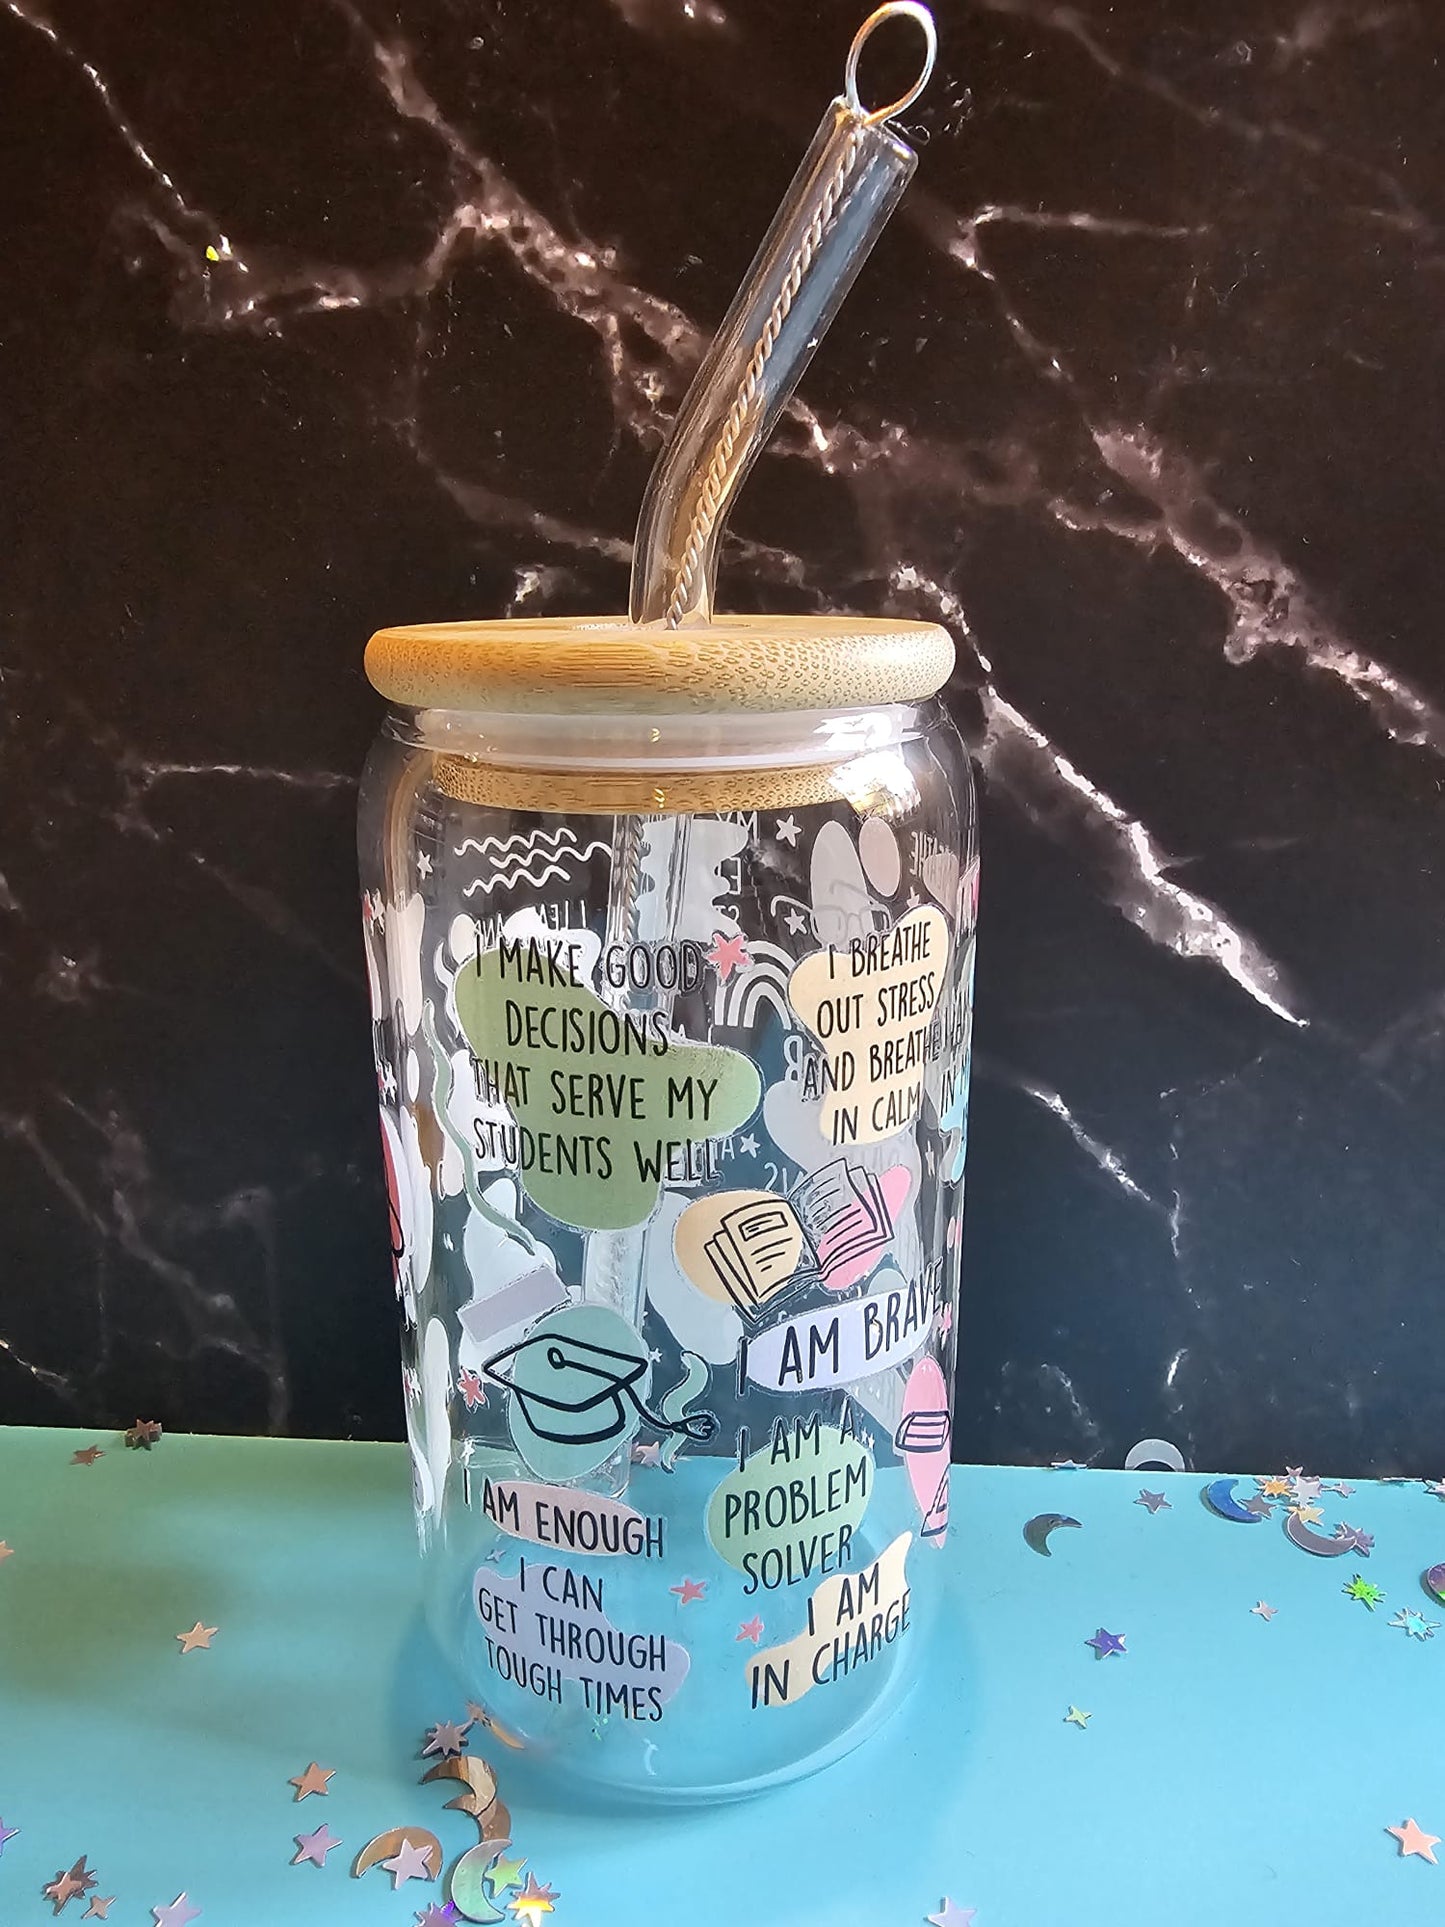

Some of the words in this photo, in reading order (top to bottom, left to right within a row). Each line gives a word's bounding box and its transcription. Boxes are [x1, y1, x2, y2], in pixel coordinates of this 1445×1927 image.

[475, 936, 483, 978] I
[500, 936, 585, 988] MAKE
[605, 944, 700, 989] GOOD
[828, 944, 836, 980] I
[851, 921, 932, 978] BREATHE
[505, 999, 669, 1056] DECISIONS
[816, 992, 865, 1039] OUT
[877, 971, 935, 1028] STRESS
[472, 1056, 531, 1108] THAT
[550, 1070, 646, 1120] SERVE
[667, 1076, 719, 1121] MY
[803, 1050, 856, 1097] AND
[869, 1018, 941, 1081] BREATHE
[473, 1117, 613, 1180] STUDENTS
[633, 1135, 720, 1183] WELL
[833, 1105, 859, 1146] IN
[872, 1081, 922, 1132] CALM
[738, 1338, 748, 1395] I
[778, 1317, 839, 1387] AM
[738, 1428, 746, 1473] I
[770, 1411, 820, 1465] AM
[839, 1396, 855, 1444] A
[463, 1467, 469, 1505] I
[483, 1478, 520, 1531] AM
[535, 1501, 663, 1558] ENOUGH
[725, 1455, 867, 1539] PROBLEM
[519, 1557, 526, 1592] I
[542, 1566, 603, 1613] CAN
[742, 1523, 853, 1595] SOLVER
[478, 1587, 518, 1634] GET
[535, 1612, 666, 1672] THROUGH
[807, 1597, 815, 1636] I
[836, 1562, 879, 1626] AM
[484, 1636, 562, 1704] TOUGH
[580, 1676, 663, 1722] TIMES
[752, 1660, 790, 1709] IN
[811, 1588, 911, 1685] CHARGE
